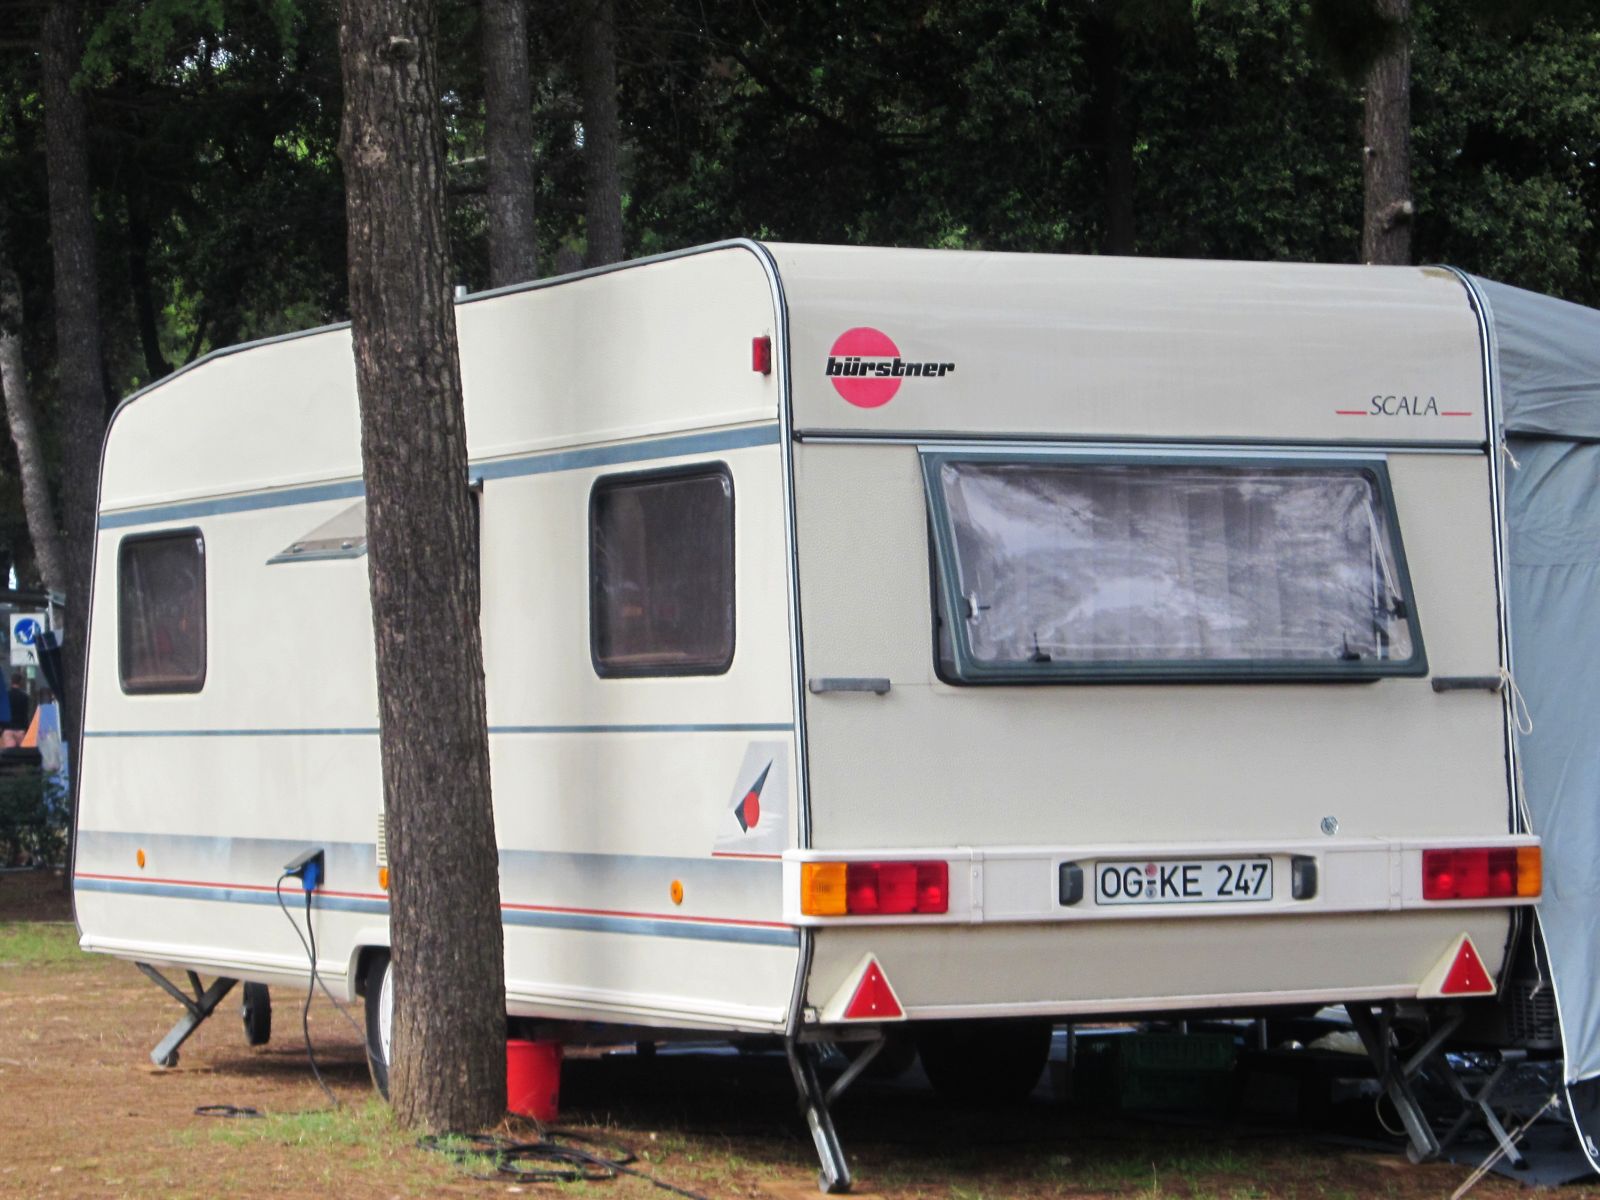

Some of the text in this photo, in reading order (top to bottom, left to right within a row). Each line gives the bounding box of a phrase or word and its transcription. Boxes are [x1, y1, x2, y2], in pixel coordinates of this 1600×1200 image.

[825, 356, 956, 378] bürstner
[1370, 395, 1439, 416] SCALA
[1217, 863, 1269, 896] 247
